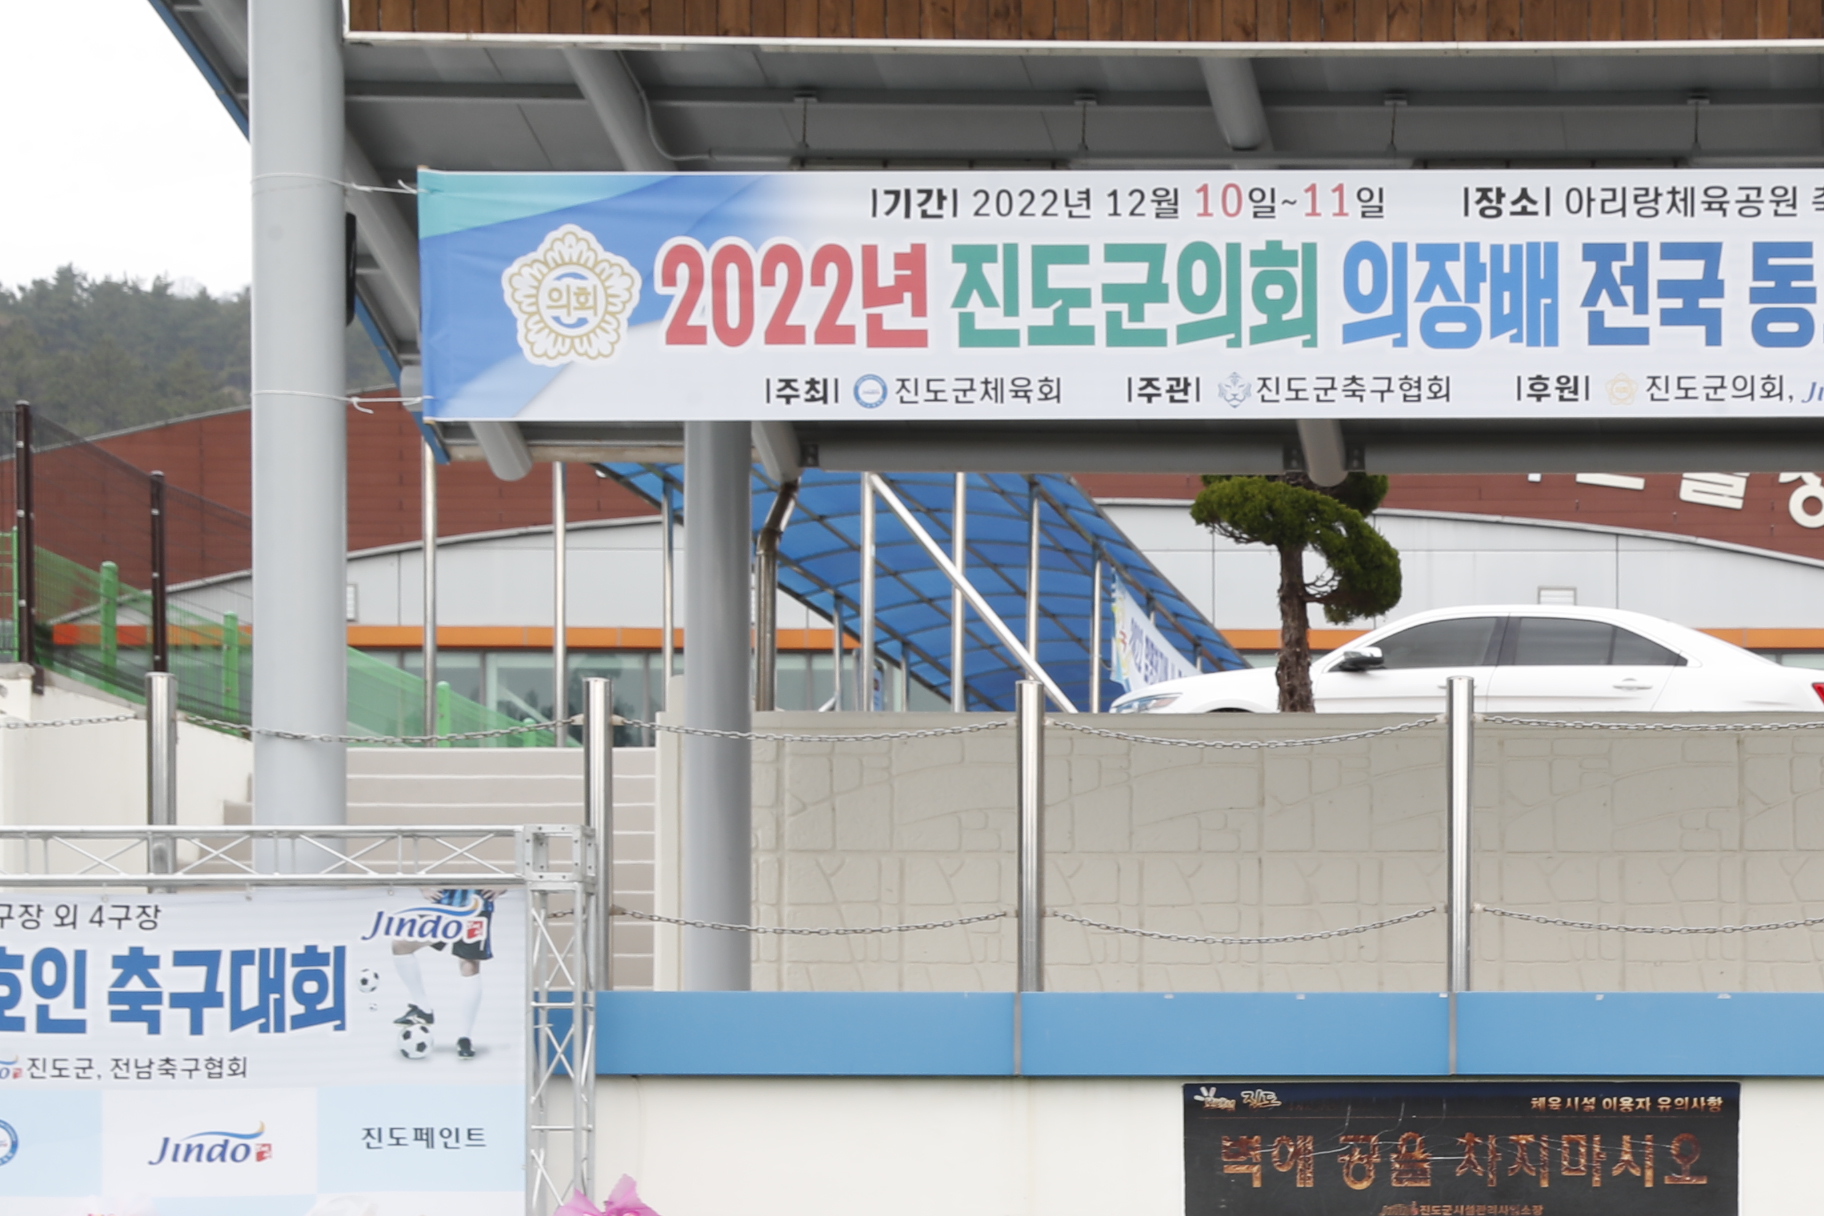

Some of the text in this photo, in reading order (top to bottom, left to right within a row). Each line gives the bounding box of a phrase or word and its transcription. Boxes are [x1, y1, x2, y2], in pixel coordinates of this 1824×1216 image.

[972, 188, 1092, 219] 2022년
[1106, 186, 1181, 219] 12월
[1564, 184, 1799, 219] 아리랑체육공원
[546, 283, 599, 319] 의회
[664, 240, 930, 348] 2022년
[950, 239, 1319, 349] 진도군의회
[1341, 239, 1560, 350] 의장배
[1580, 240, 1726, 347] 전국
[895, 375, 1062, 405] 진도군체육회
[1256, 374, 1452, 404] 진도군축구협회
[1646, 373, 1795, 404] 진도군의회,
[53, 903, 79, 929] 외
[88, 902, 162, 929] 4구장
[361, 911, 463, 941] Jindo
[107, 943, 348, 1037] 축구대회
[27, 1056, 102, 1081] 진도군,
[110, 1055, 248, 1080] 전남축구협회
[1530, 1096, 1724, 1113] 체육시설 이용자 유의사항
[147, 1137, 252, 1166] Jindo
[360, 1125, 488, 1151] 진도페인트
[1221, 1133, 1315, 1189] 벽에
[1455, 1132, 1709, 1190] 차지마시오
